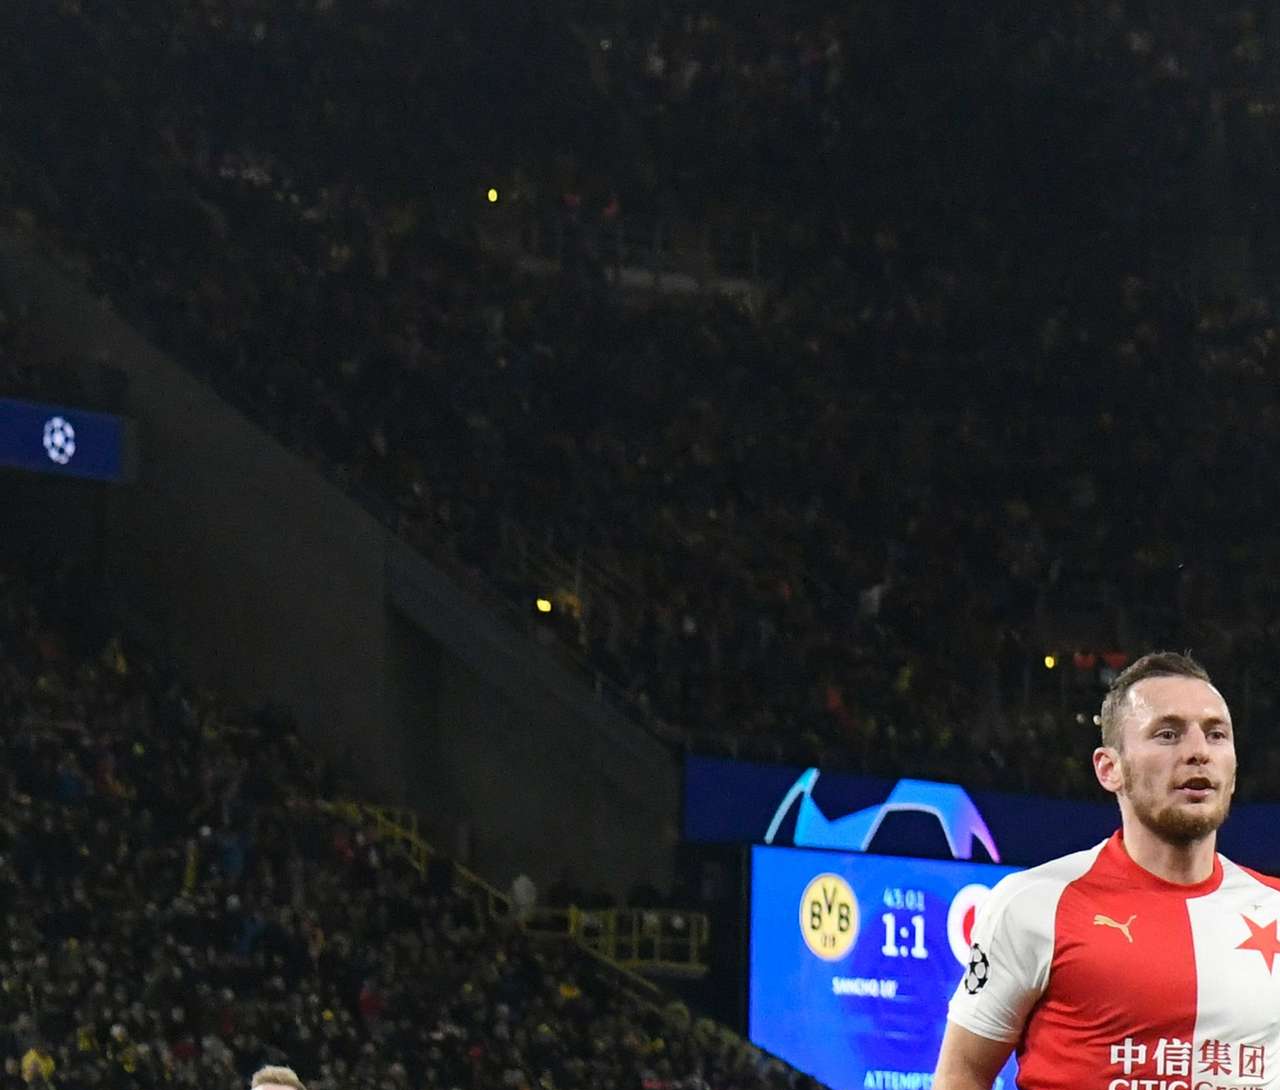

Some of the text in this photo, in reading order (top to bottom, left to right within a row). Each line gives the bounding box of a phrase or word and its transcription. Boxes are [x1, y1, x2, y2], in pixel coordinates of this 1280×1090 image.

[881, 912, 929, 960] 1:1
[1109, 1037, 1266, 1081] 中信集团
